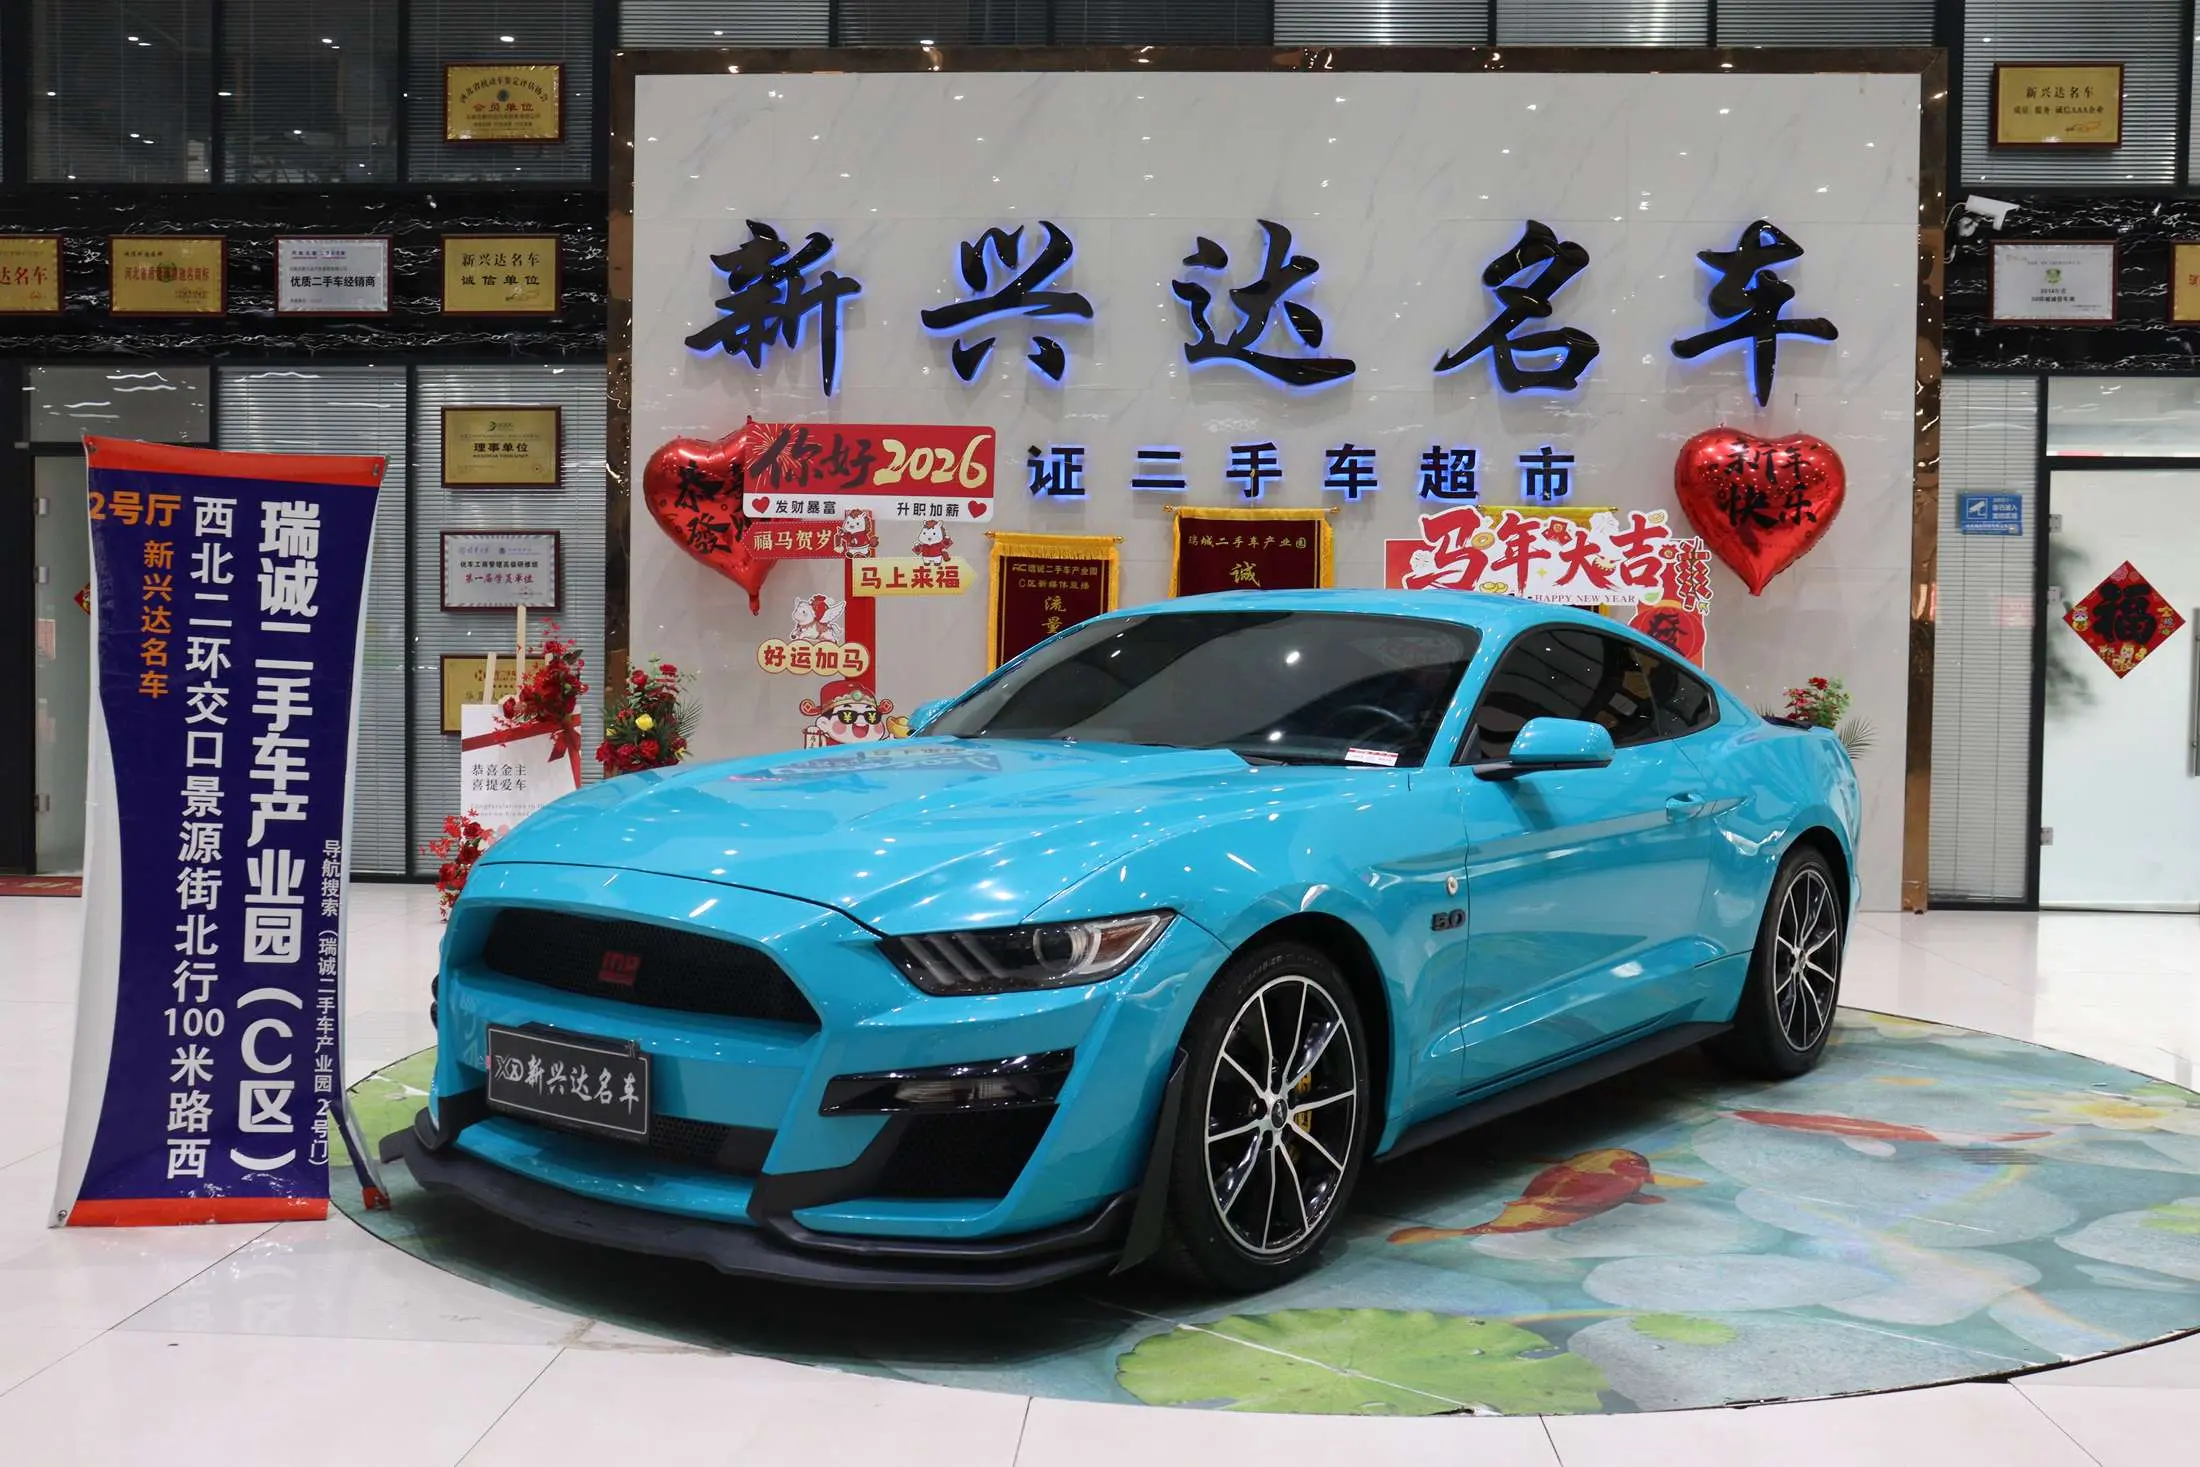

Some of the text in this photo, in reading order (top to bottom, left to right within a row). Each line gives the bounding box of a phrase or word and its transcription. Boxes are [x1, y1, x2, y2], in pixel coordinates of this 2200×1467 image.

[2026, 85, 2094, 98] 新兴达名车
[473, 102, 534, 112] 会员单位
[462, 252, 540, 267] 新兴达名车
[290, 275, 376, 288] 优质二手车经销商
[461, 275, 540, 286] 诚信单位
[685, 219, 1839, 407] 新兴达名车
[473, 442, 529, 453] 理事单位
[1027, 442, 1576, 500] 证二手车超市
[88, 489, 183, 528] 2号厅
[775, 500, 837, 516] 发财暴富
[896, 501, 960, 517] 升职加薪
[753, 530, 832, 551] 福马贺岁
[1408, 505, 1670, 595] 马年大吉
[861, 565, 961, 590] 马上来福
[1535, 594, 1636, 604] HAPPY NEW YEAR
[138, 539, 175, 699] 新兴达名车
[2092, 582, 2157, 645] 福
[763, 645, 865, 671] 好运加马
[472, 763, 528, 777] 恭喜金主
[472, 778, 528, 791] 喜提爱车
[164, 496, 238, 1179] 西北二环交口景源街北行100米路西
[525, 1054, 640, 1115] 新兴达名车
